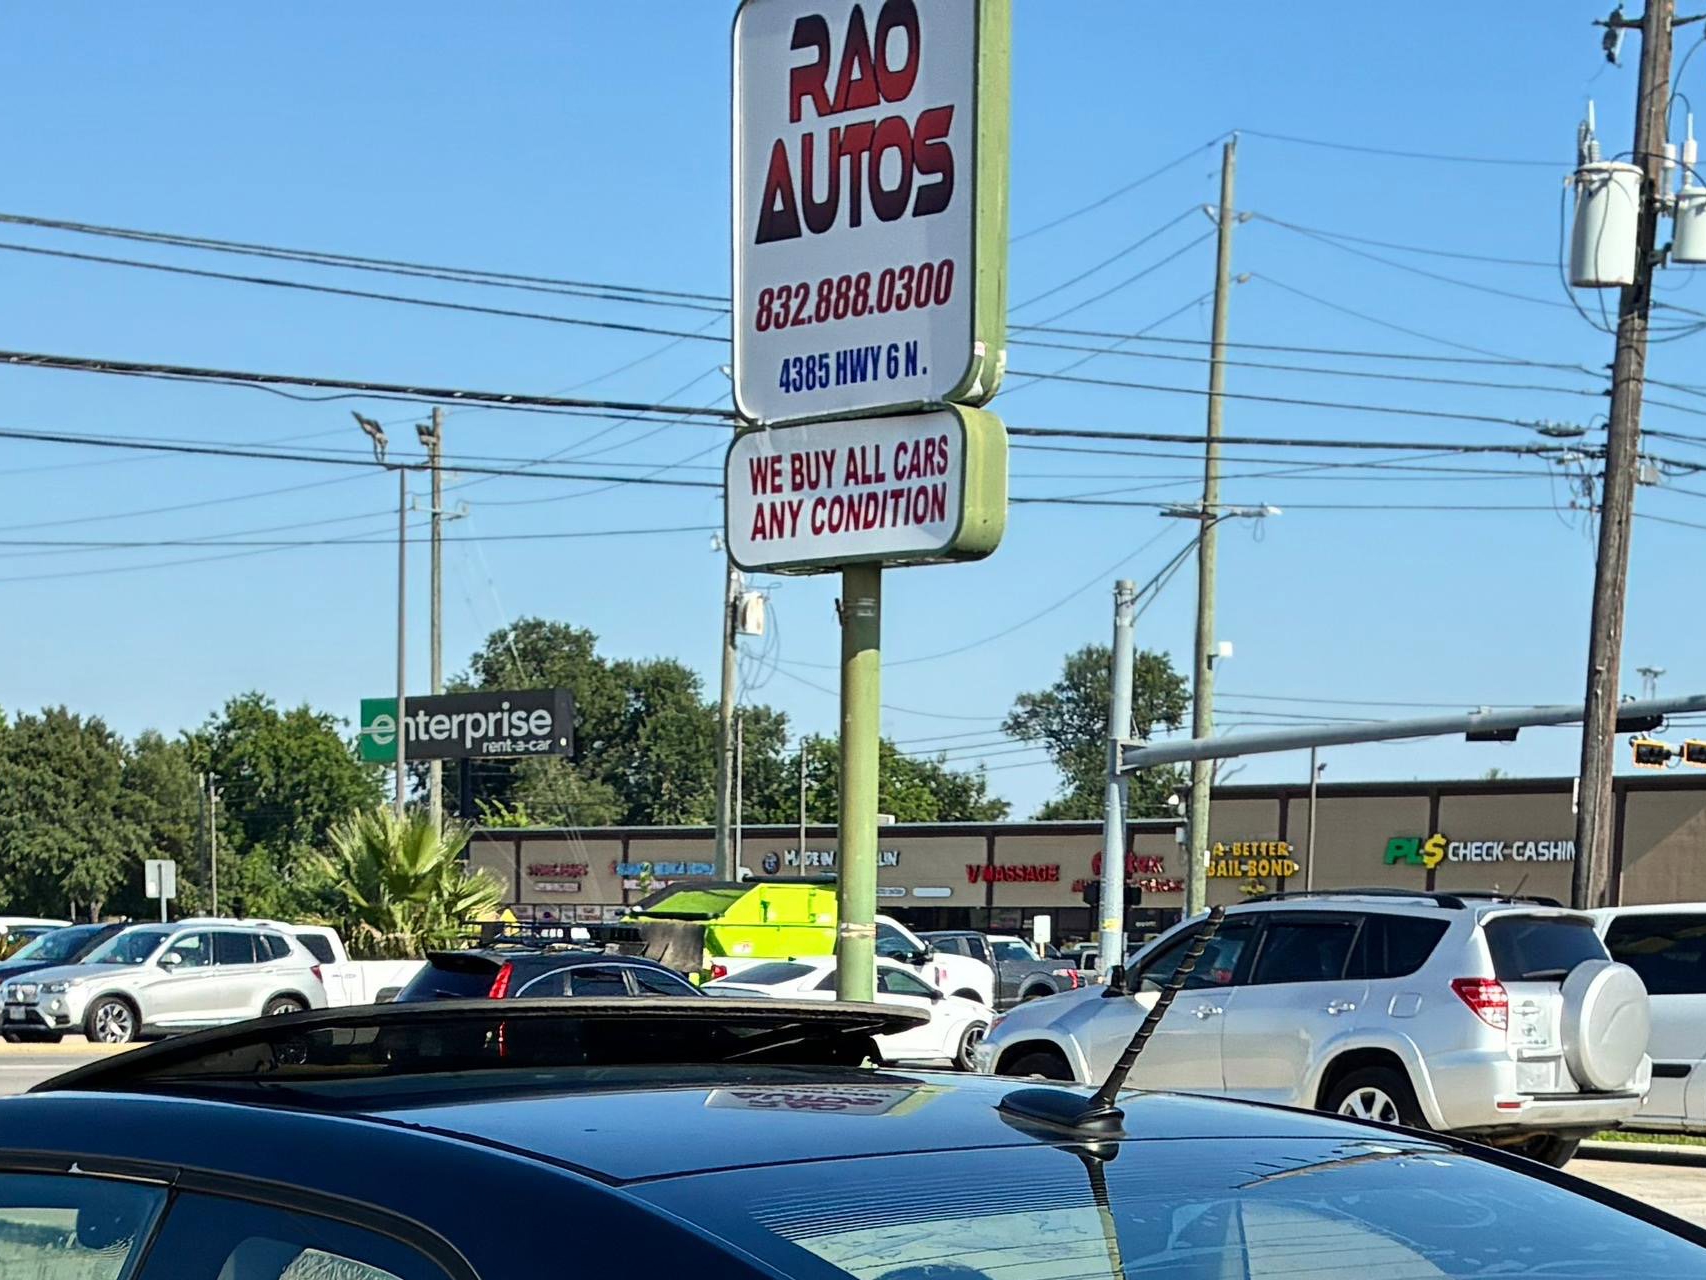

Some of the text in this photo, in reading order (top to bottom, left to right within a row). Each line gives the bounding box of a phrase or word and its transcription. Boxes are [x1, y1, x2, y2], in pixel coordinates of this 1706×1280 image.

[789, 0, 921, 124] RAO
[754, 104, 955, 245] AUTOS
[755, 258, 955, 333] 832.888.0300
[779, 352, 831, 394] 4385
[835, 345, 883, 387] HWY
[886, 342, 900, 380] 6
[749, 434, 949, 496] WE BUY ALL CARS
[750, 481, 948, 542] ANY CONDITION
[367, 701, 553, 749] enterprise
[482, 739, 553, 754] rent-a-car
[1233, 841, 1290, 857] BETTER
[1447, 841, 1504, 863] CHECK
